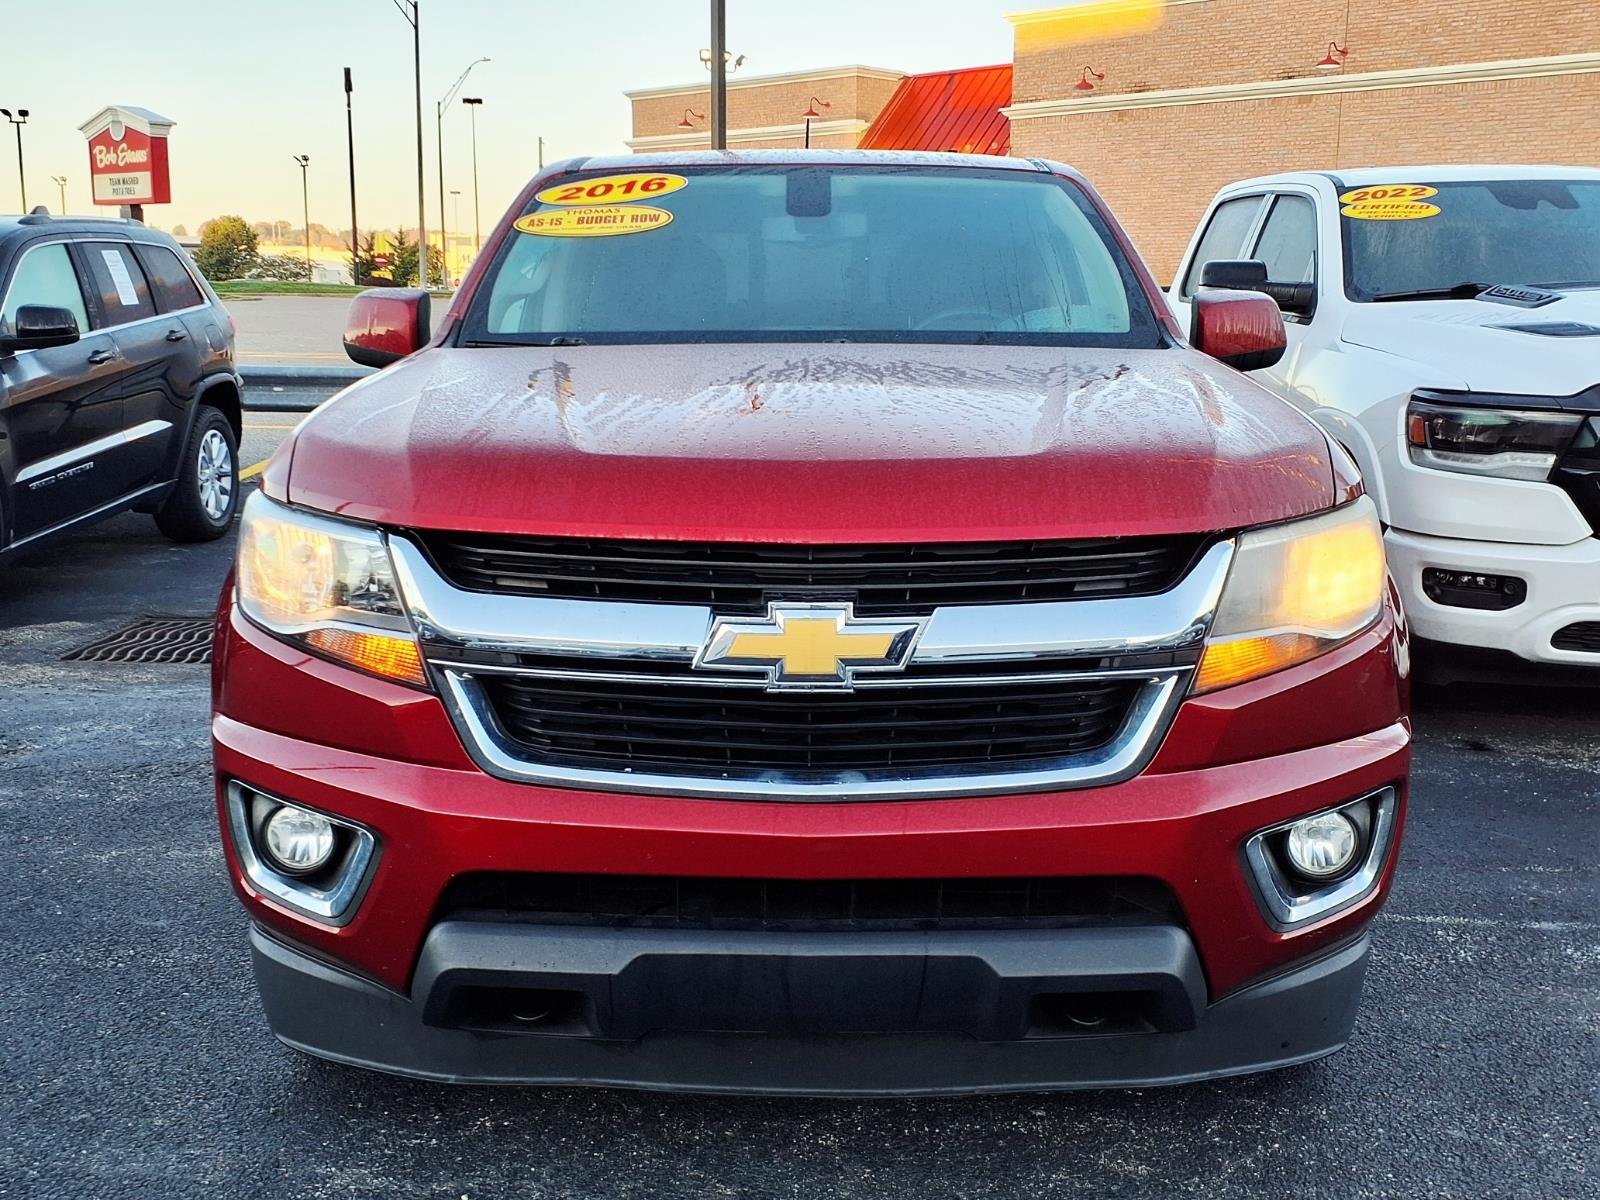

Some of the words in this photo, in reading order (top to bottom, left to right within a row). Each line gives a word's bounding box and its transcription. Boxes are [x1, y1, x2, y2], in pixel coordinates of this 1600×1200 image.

[93, 145, 117, 168] Bob
[112, 187, 136, 196] POTATOES
[553, 177, 669, 202] 2016
[1350, 187, 1427, 202] 2022
[566, 208, 621, 216] THOMAS
[527, 217, 563, 227] AS-IS
[576, 214, 626, 225] BUDGET
[630, 213, 661, 223] ROW
